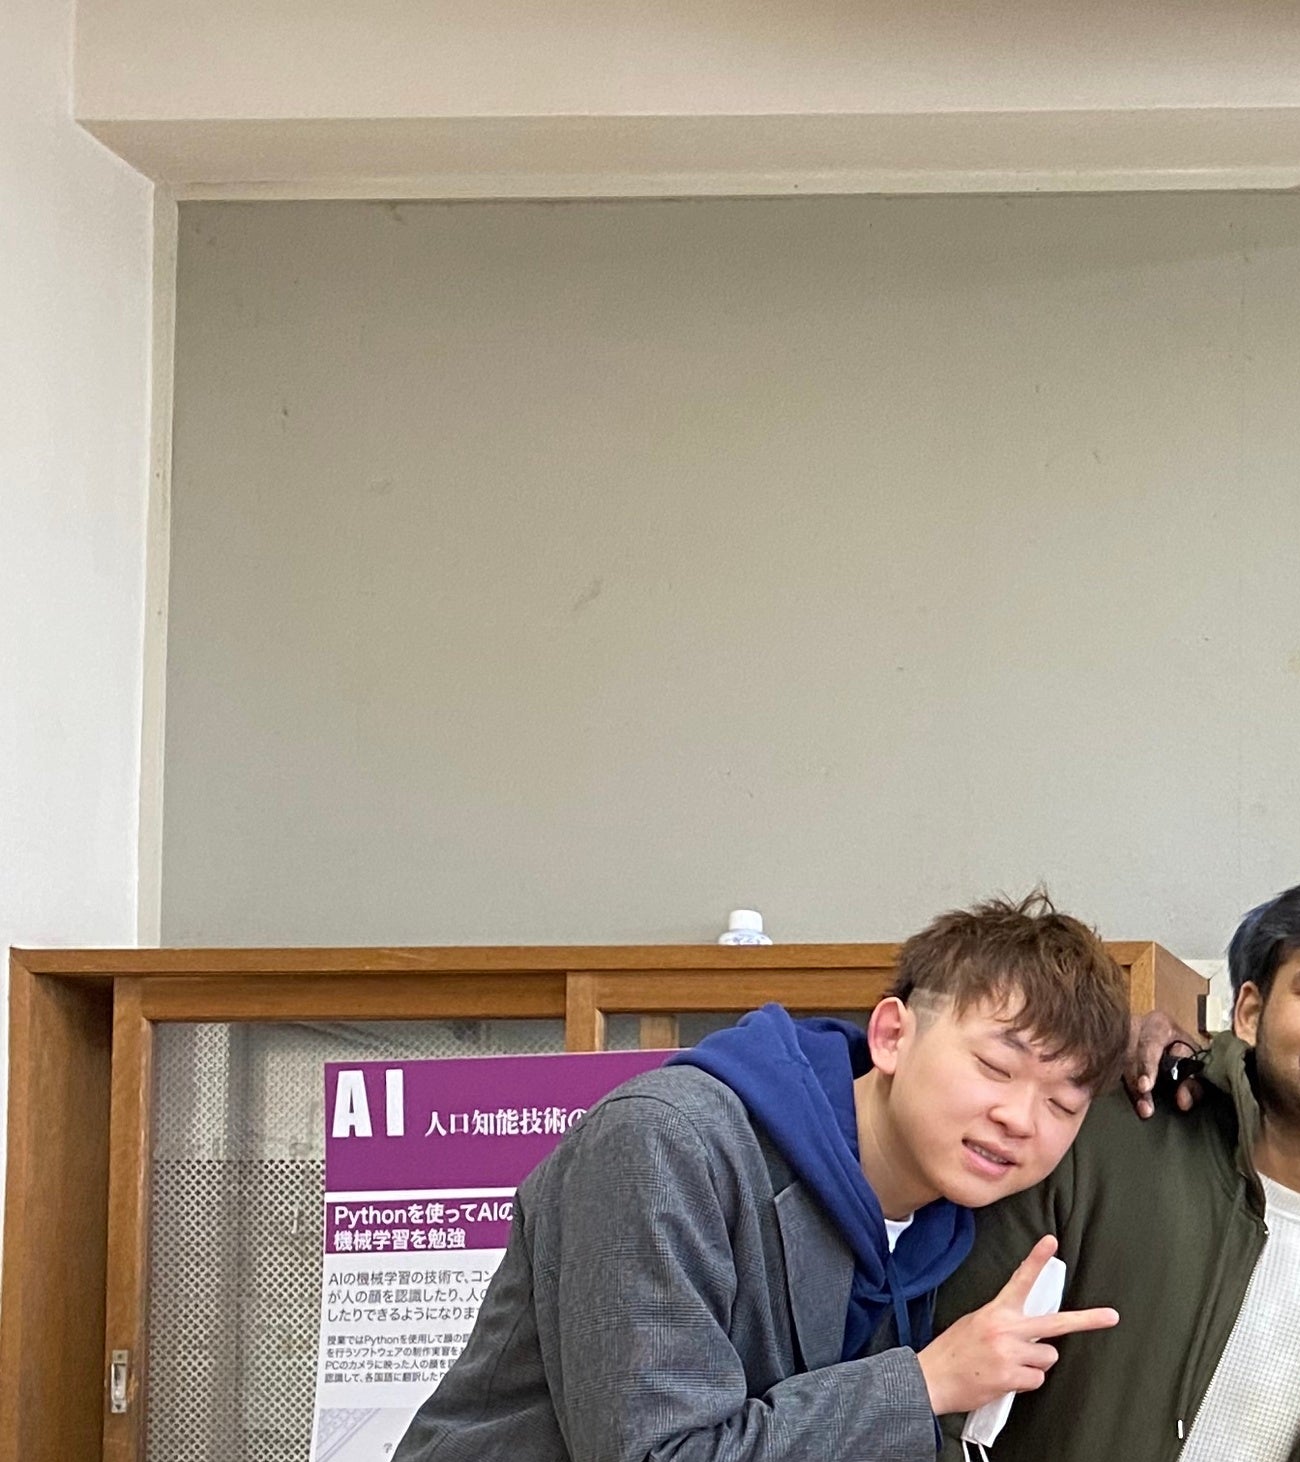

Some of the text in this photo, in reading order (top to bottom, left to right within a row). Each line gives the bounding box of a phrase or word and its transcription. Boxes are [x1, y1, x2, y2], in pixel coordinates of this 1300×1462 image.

[332, 1069, 405, 1138] AI
[334, 1228, 466, 1251] 機械学習を勉強
